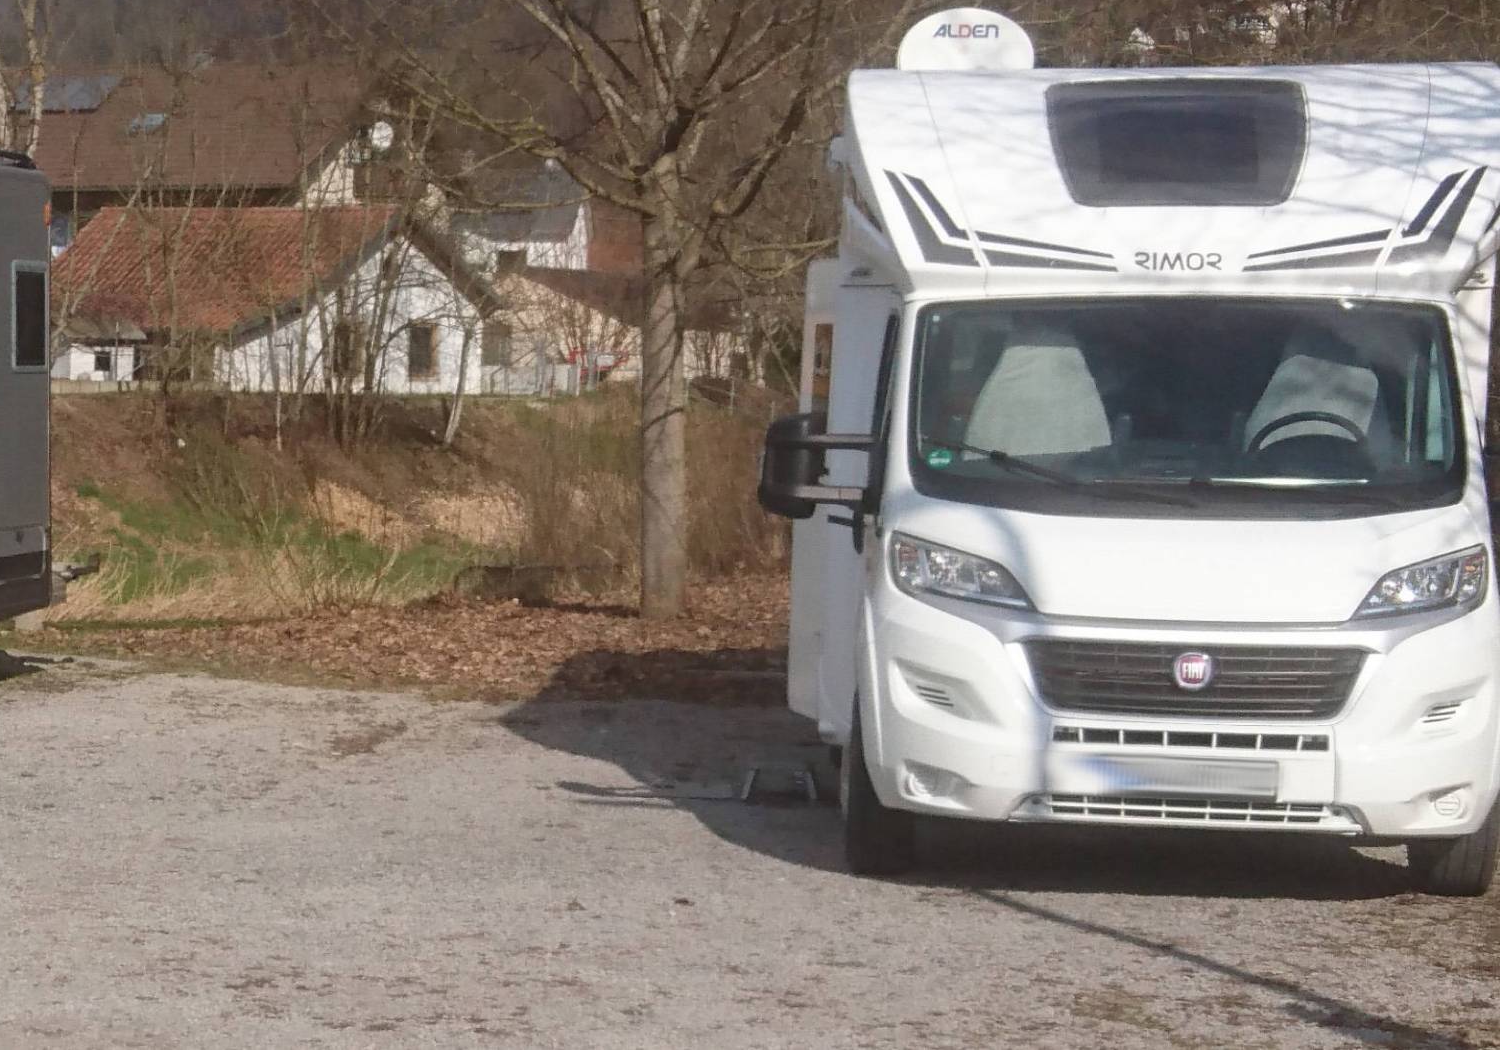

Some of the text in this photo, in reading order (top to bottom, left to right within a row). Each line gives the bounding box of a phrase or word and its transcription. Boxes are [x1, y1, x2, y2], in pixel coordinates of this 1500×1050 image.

[933, 24, 999, 38] ALDEN
[1134, 252, 1222, 270] RIMOR
[1182, 662, 1205, 679] FIAT
